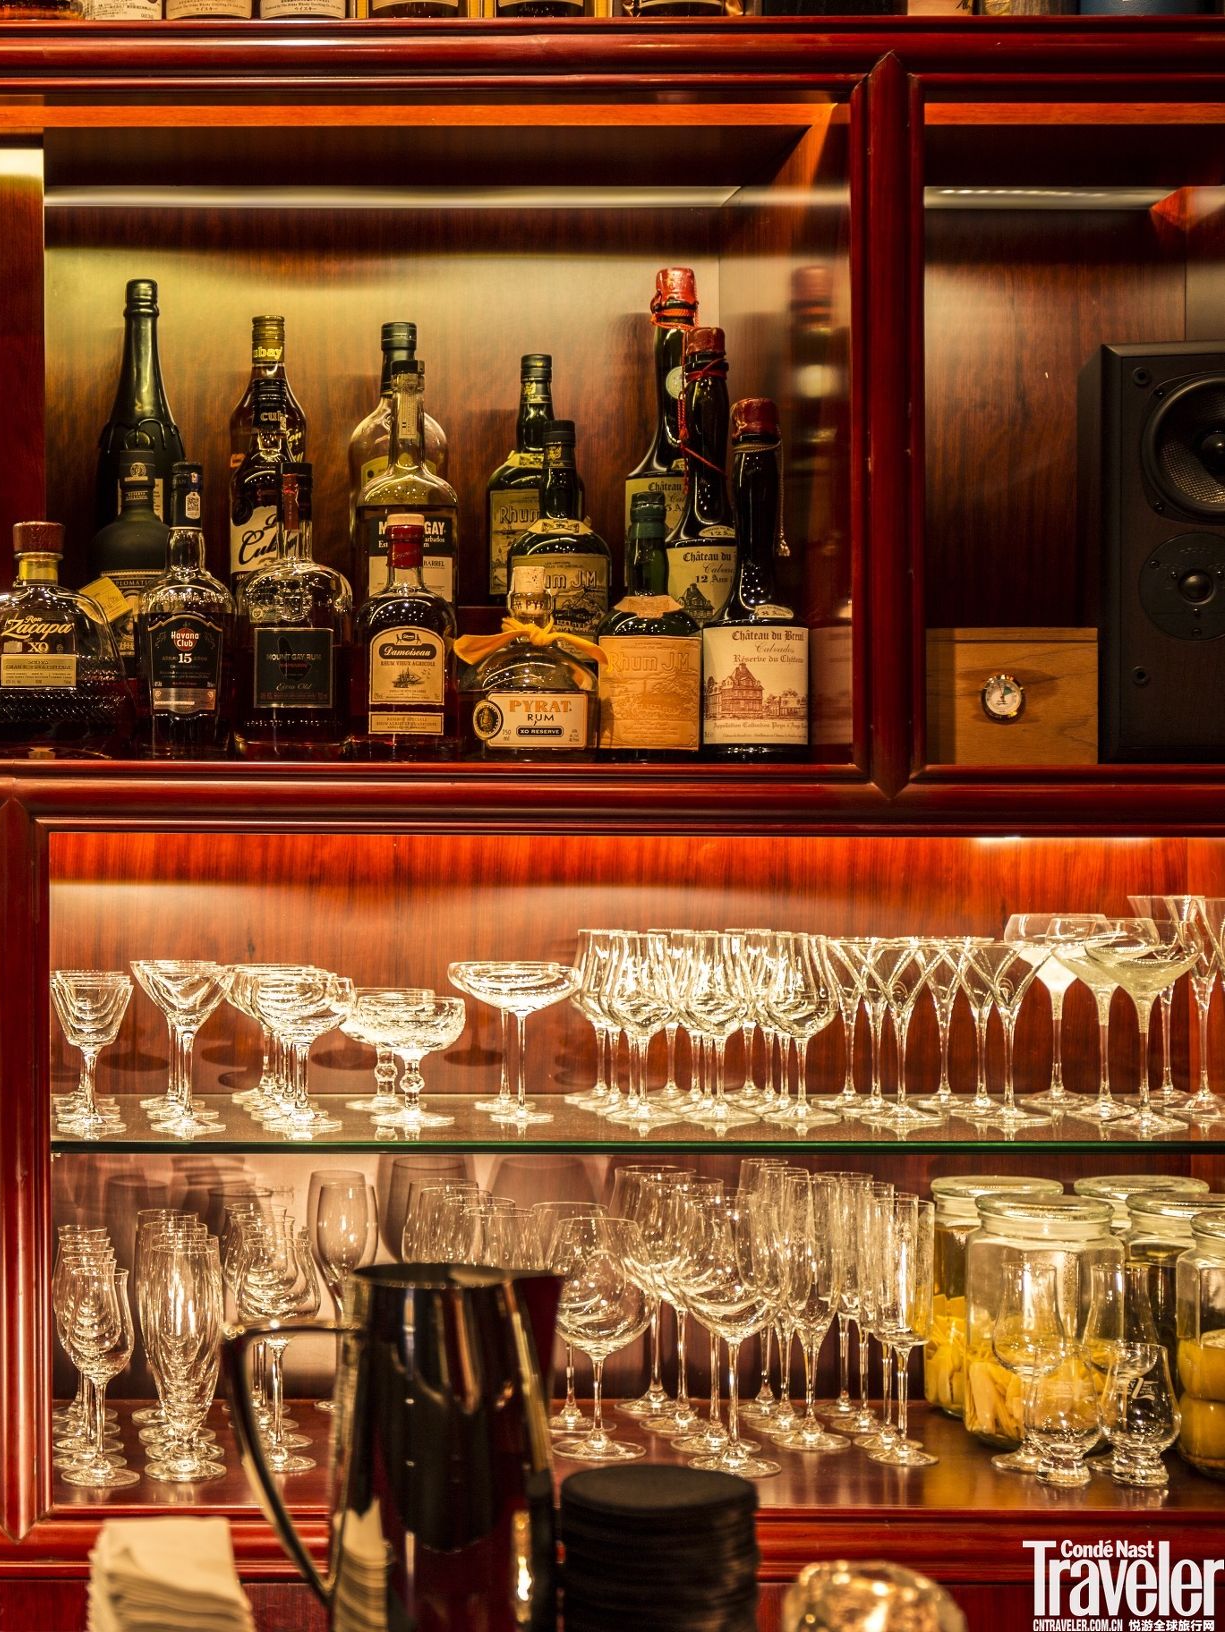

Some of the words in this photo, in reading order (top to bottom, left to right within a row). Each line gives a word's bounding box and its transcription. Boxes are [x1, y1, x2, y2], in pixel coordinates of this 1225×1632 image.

[682, 552, 719, 562] Château
[721, 552, 731, 561] du
[695, 575, 708, 584] 12
[1, 618, 75, 641] Zacapa
[170, 630, 200, 640] Havana
[732, 629, 769, 641] Château
[771, 630, 782, 641] du
[27, 642, 49, 654] XO
[176, 639, 194, 647] Club
[383, 645, 432, 657] Damoiseau
[178, 652, 193, 664] 15
[607, 651, 658, 673] Rhum
[509, 699, 570, 713] PYRAT
[527, 713, 554, 726] RUM
